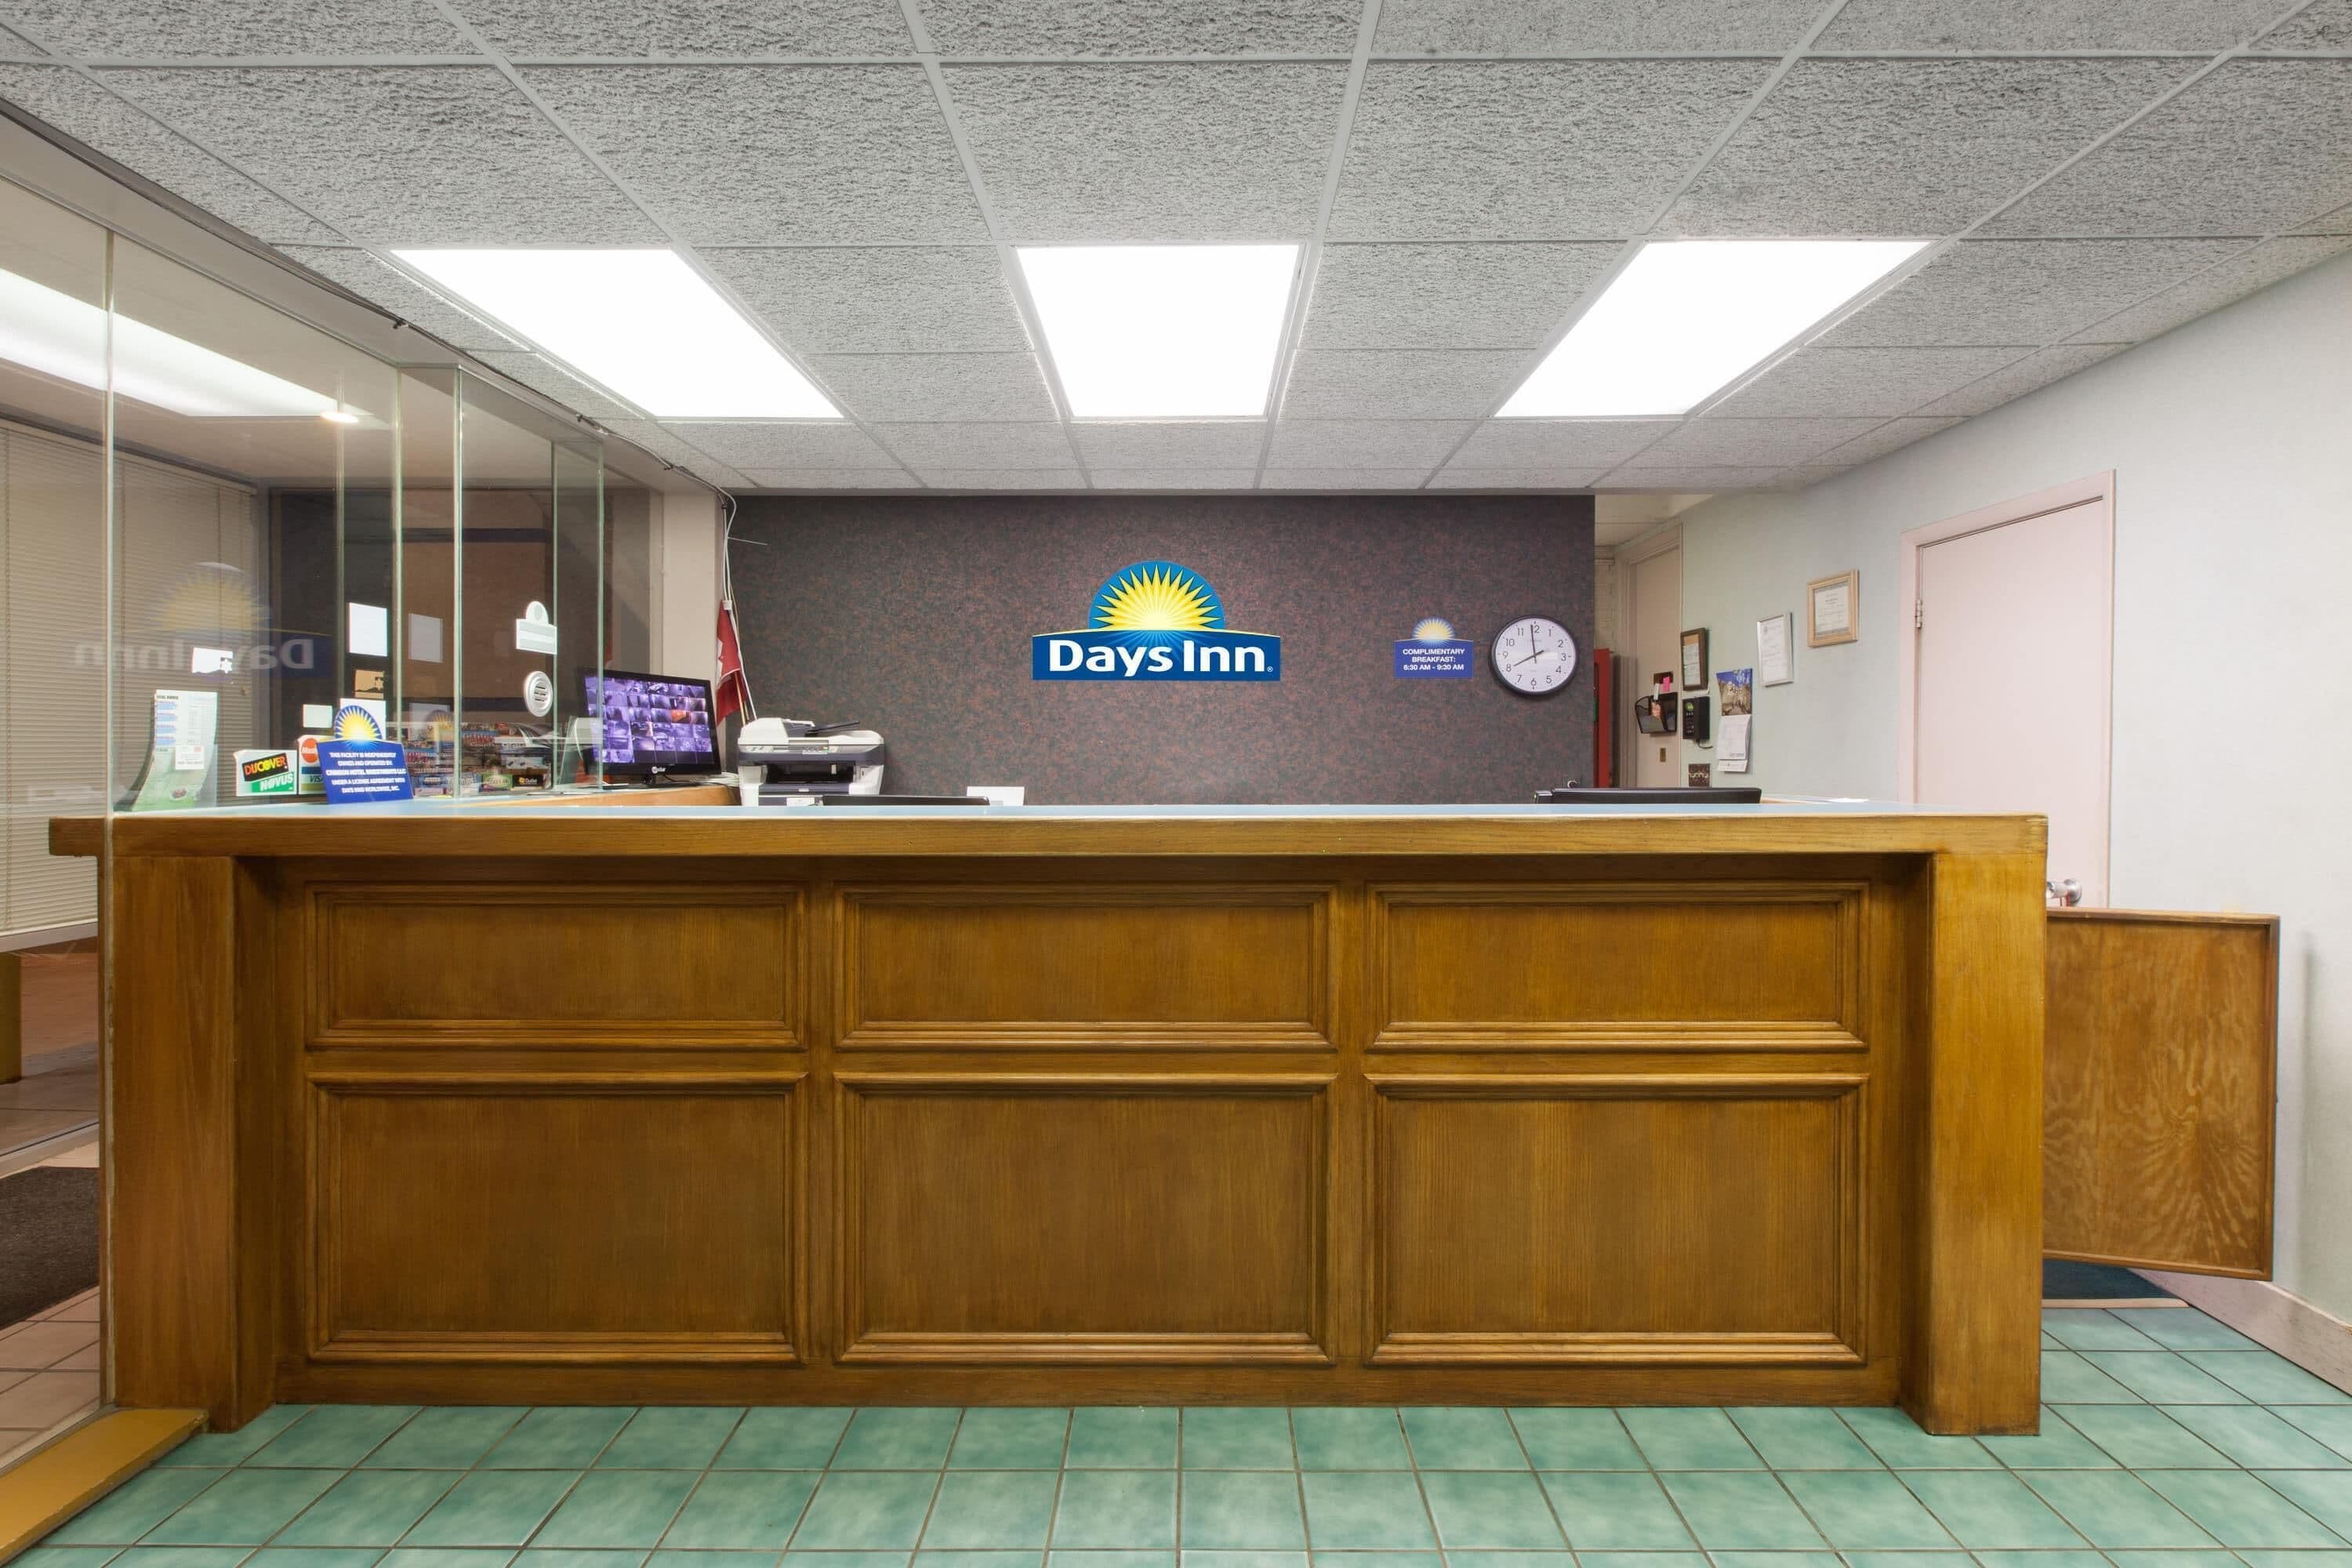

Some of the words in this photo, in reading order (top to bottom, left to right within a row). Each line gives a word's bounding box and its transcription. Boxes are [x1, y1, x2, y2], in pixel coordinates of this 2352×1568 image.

[1517, 627, 1524, 637] 11
[1505, 638, 1515, 647] 10
[1558, 639, 1563, 648] 2
[1049, 639, 1173, 677] Days
[1183, 640, 1265, 672] Inn
[1502, 651, 1508, 659] 9
[1505, 664, 1512, 673] 8
[1517, 674, 1523, 683] 7
[1530, 677, 1537, 686] 6
[1546, 675, 1552, 684] 5
[244, 755, 286, 775] DISCOVER
[260, 772, 293, 791] NOVUS
